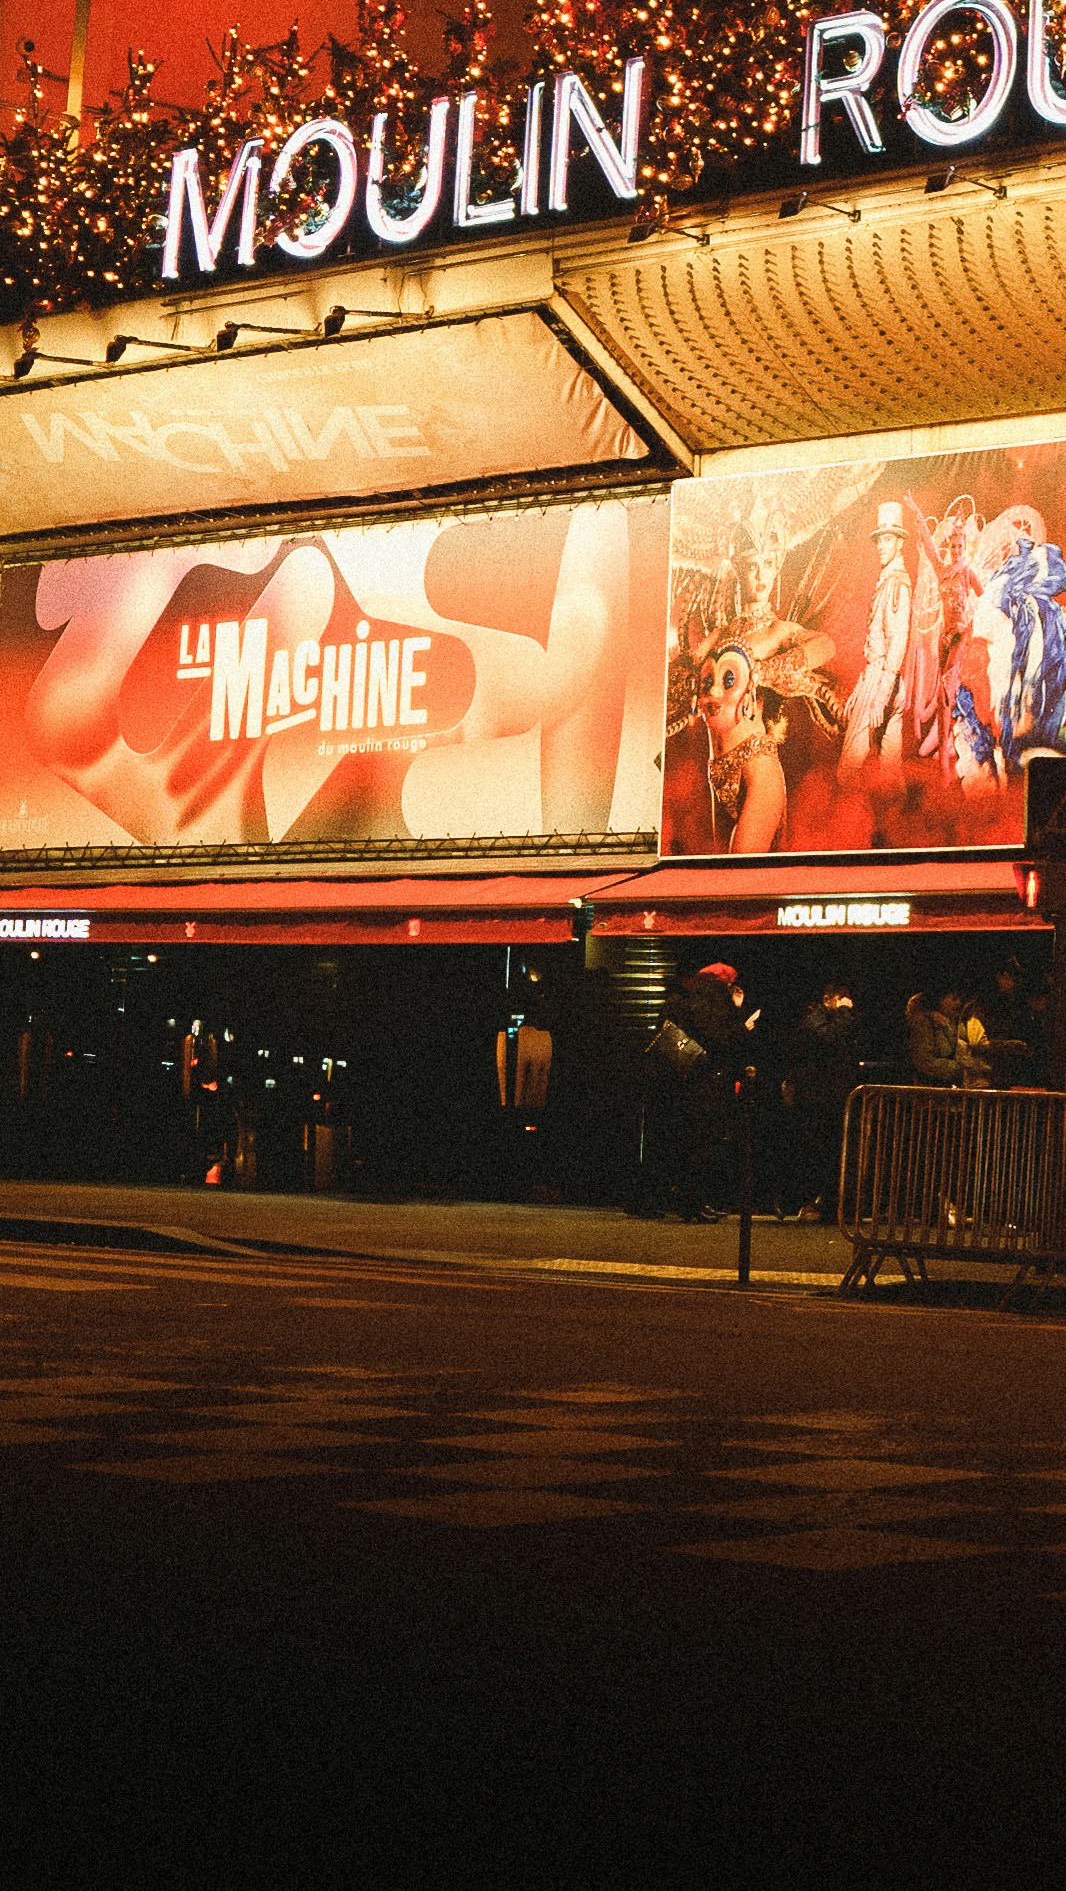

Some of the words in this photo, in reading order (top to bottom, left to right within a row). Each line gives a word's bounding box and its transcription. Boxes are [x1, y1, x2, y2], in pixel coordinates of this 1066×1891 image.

[161, 56, 646, 279] MOULIN
[179, 623, 211, 665] LA
[338, 738, 383, 754] moulin
[387, 738, 427, 754] rouge
[777, 904, 846, 927] MOULIN
[847, 903, 911, 926] ROUGE
[0, 918, 41, 938] OULIN
[41, 918, 91, 939] ROUGE
